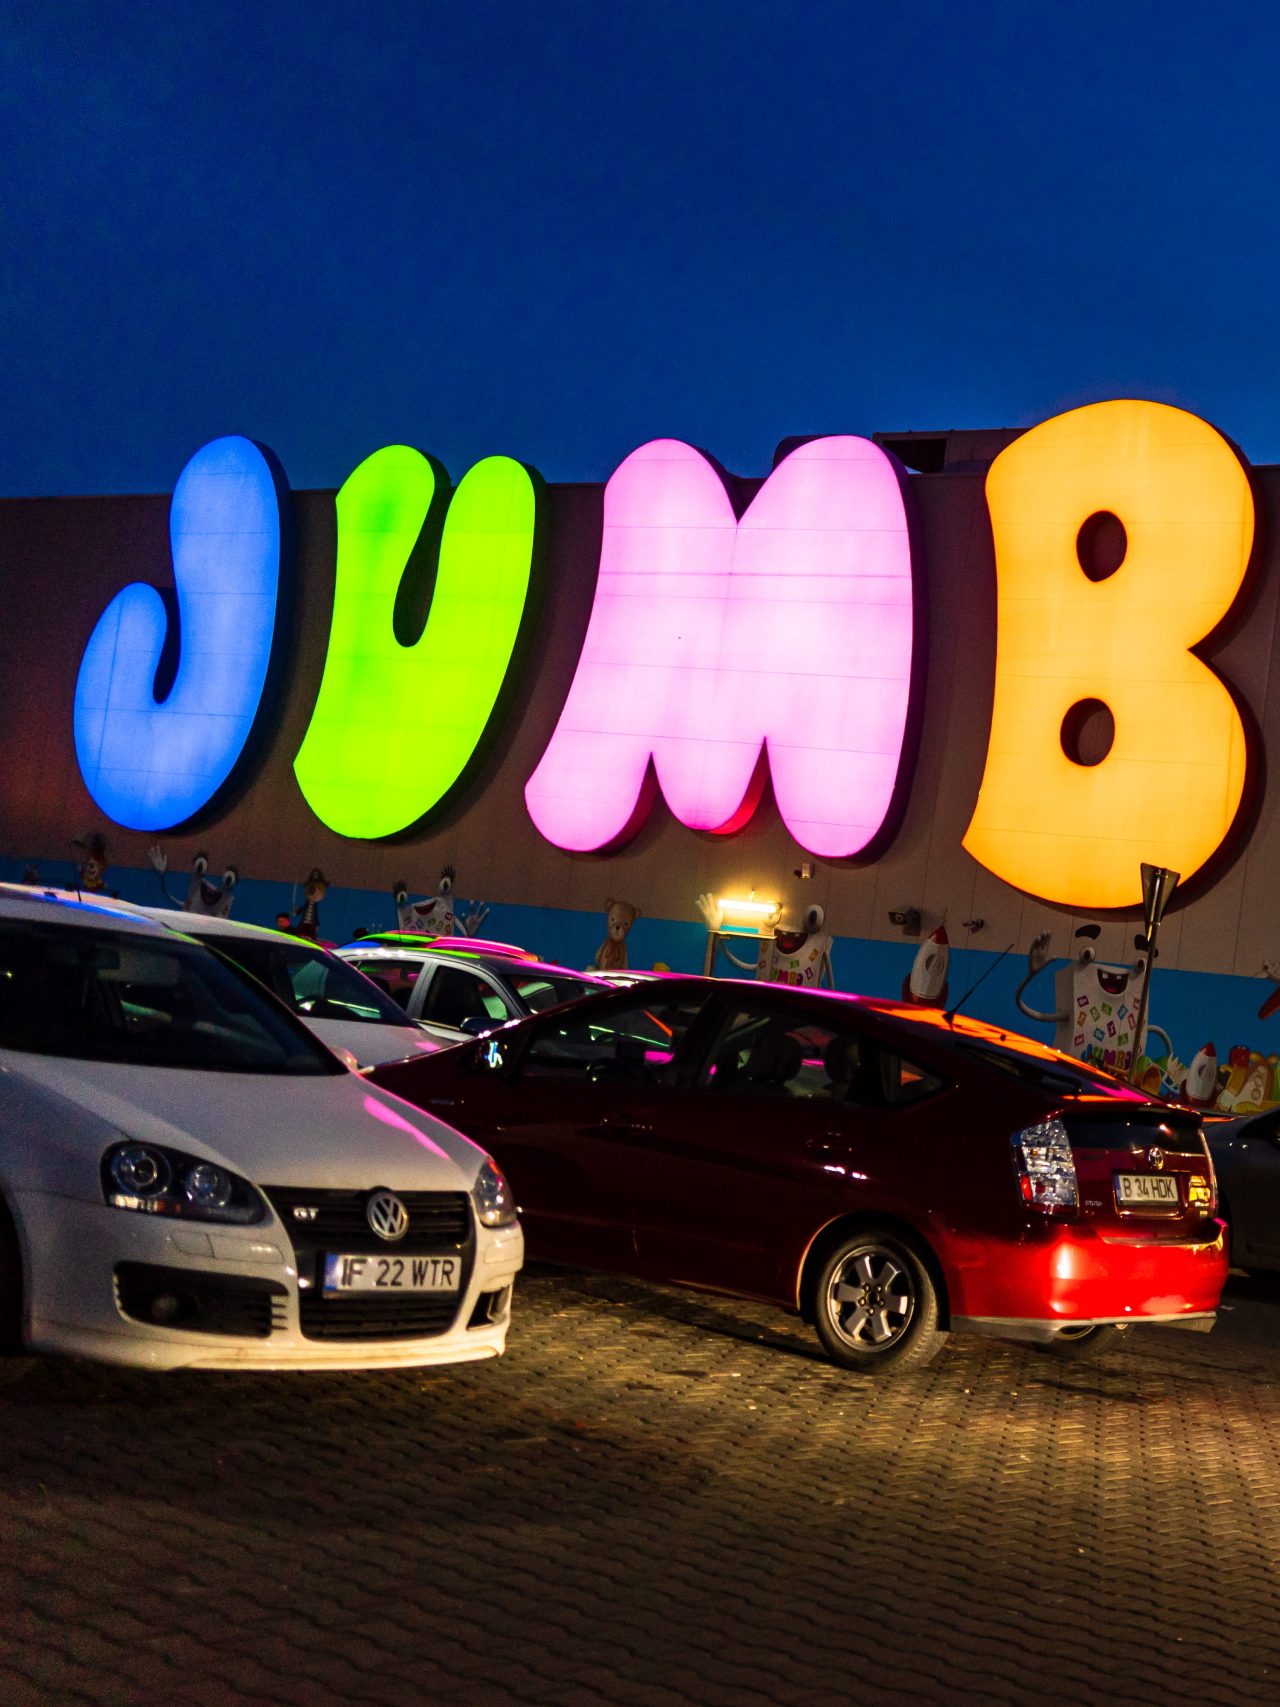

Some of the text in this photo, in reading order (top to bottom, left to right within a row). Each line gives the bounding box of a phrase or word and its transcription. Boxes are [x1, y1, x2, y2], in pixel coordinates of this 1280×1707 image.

[1122, 1177, 1176, 1199] B 34 HDK
[341, 1257, 455, 1287] IF 22 WTR
